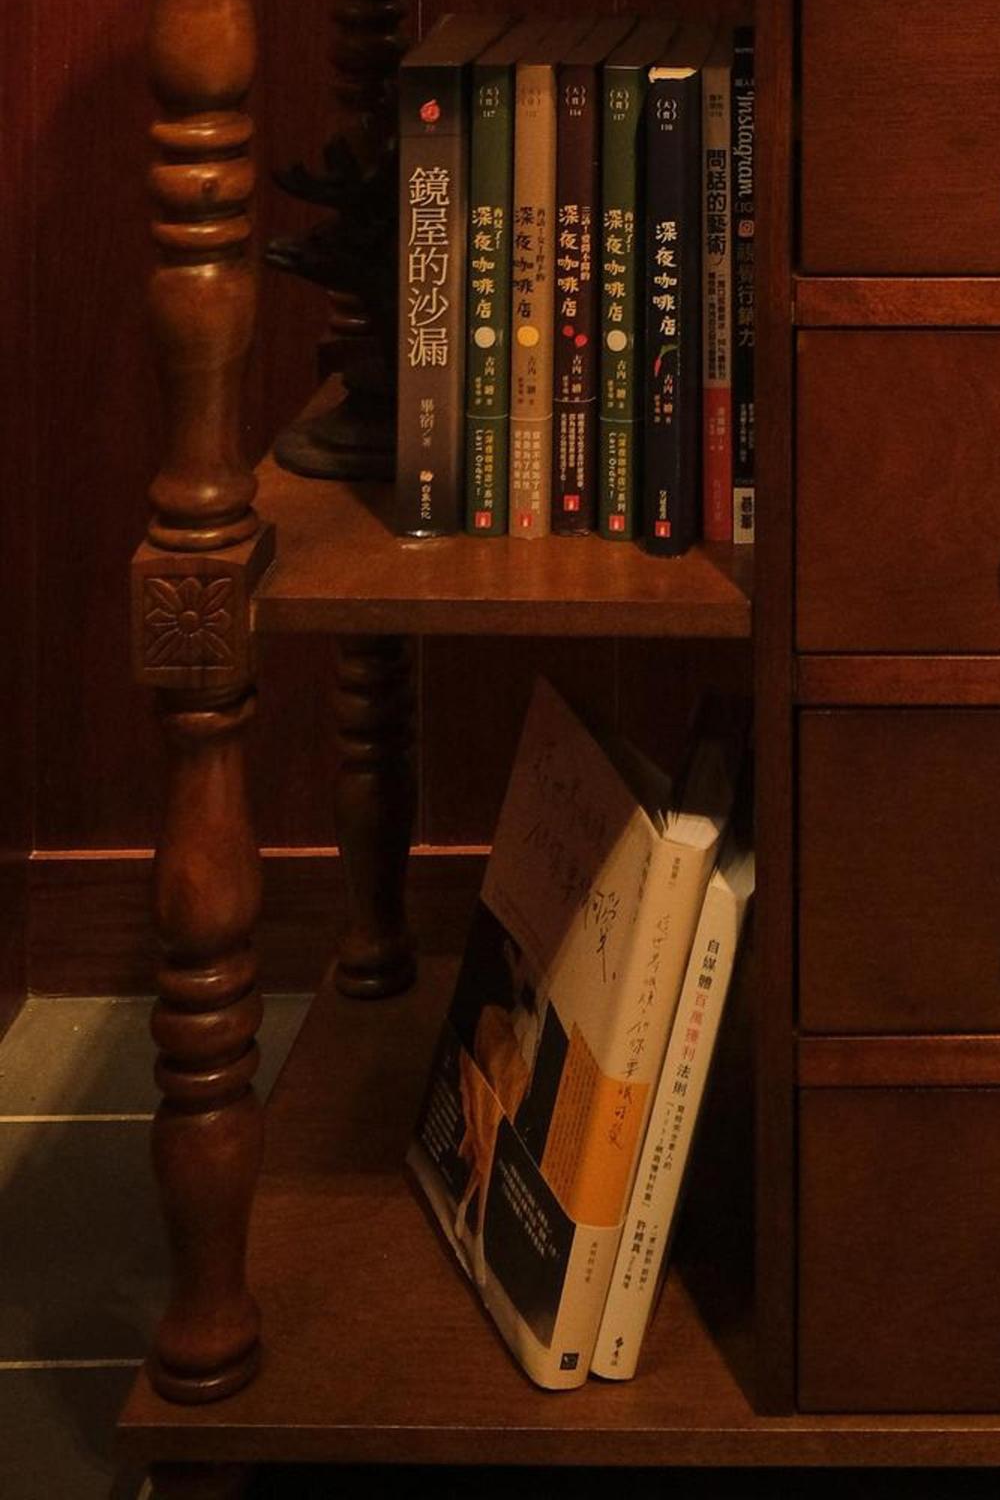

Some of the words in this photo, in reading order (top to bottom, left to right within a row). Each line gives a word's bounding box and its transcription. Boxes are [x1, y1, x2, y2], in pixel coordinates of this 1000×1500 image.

[408, 167, 451, 367] 鏡屋的沙漏
[472, 205, 495, 319] 深夜咖啡店
[513, 205, 536, 319] 深夜咖啡店
[557, 204, 581, 318] 深夜咖啡店
[604, 209, 627, 322] 深夜咖啡店
[653, 221, 678, 336] 深夜咖啡店
